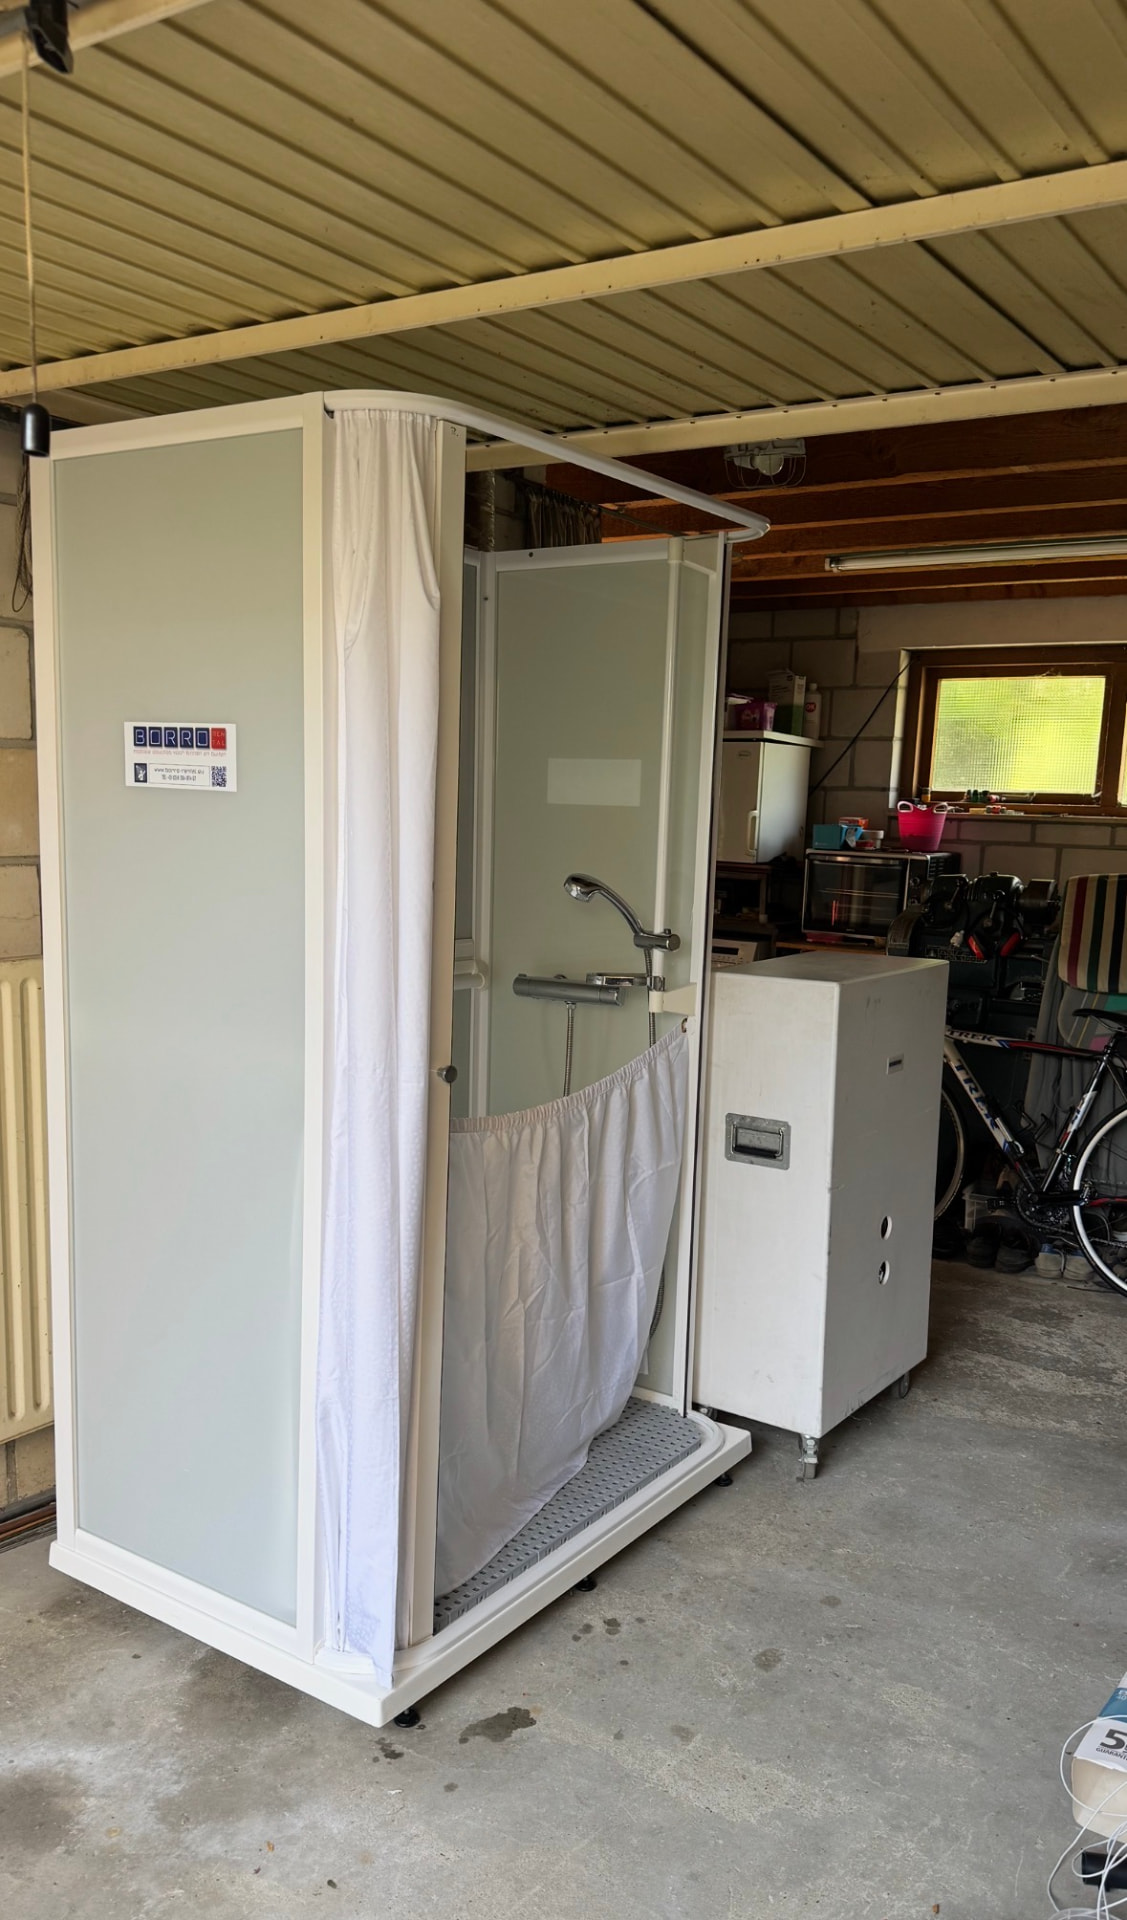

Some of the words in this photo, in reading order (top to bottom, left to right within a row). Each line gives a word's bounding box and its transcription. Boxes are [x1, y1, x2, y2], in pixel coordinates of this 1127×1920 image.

[134, 728, 209, 747] BORRO
[948, 1029, 994, 1042] TREK
[955, 1060, 999, 1130] TREK
[1096, 1747, 1127, 1760] GUARANT
